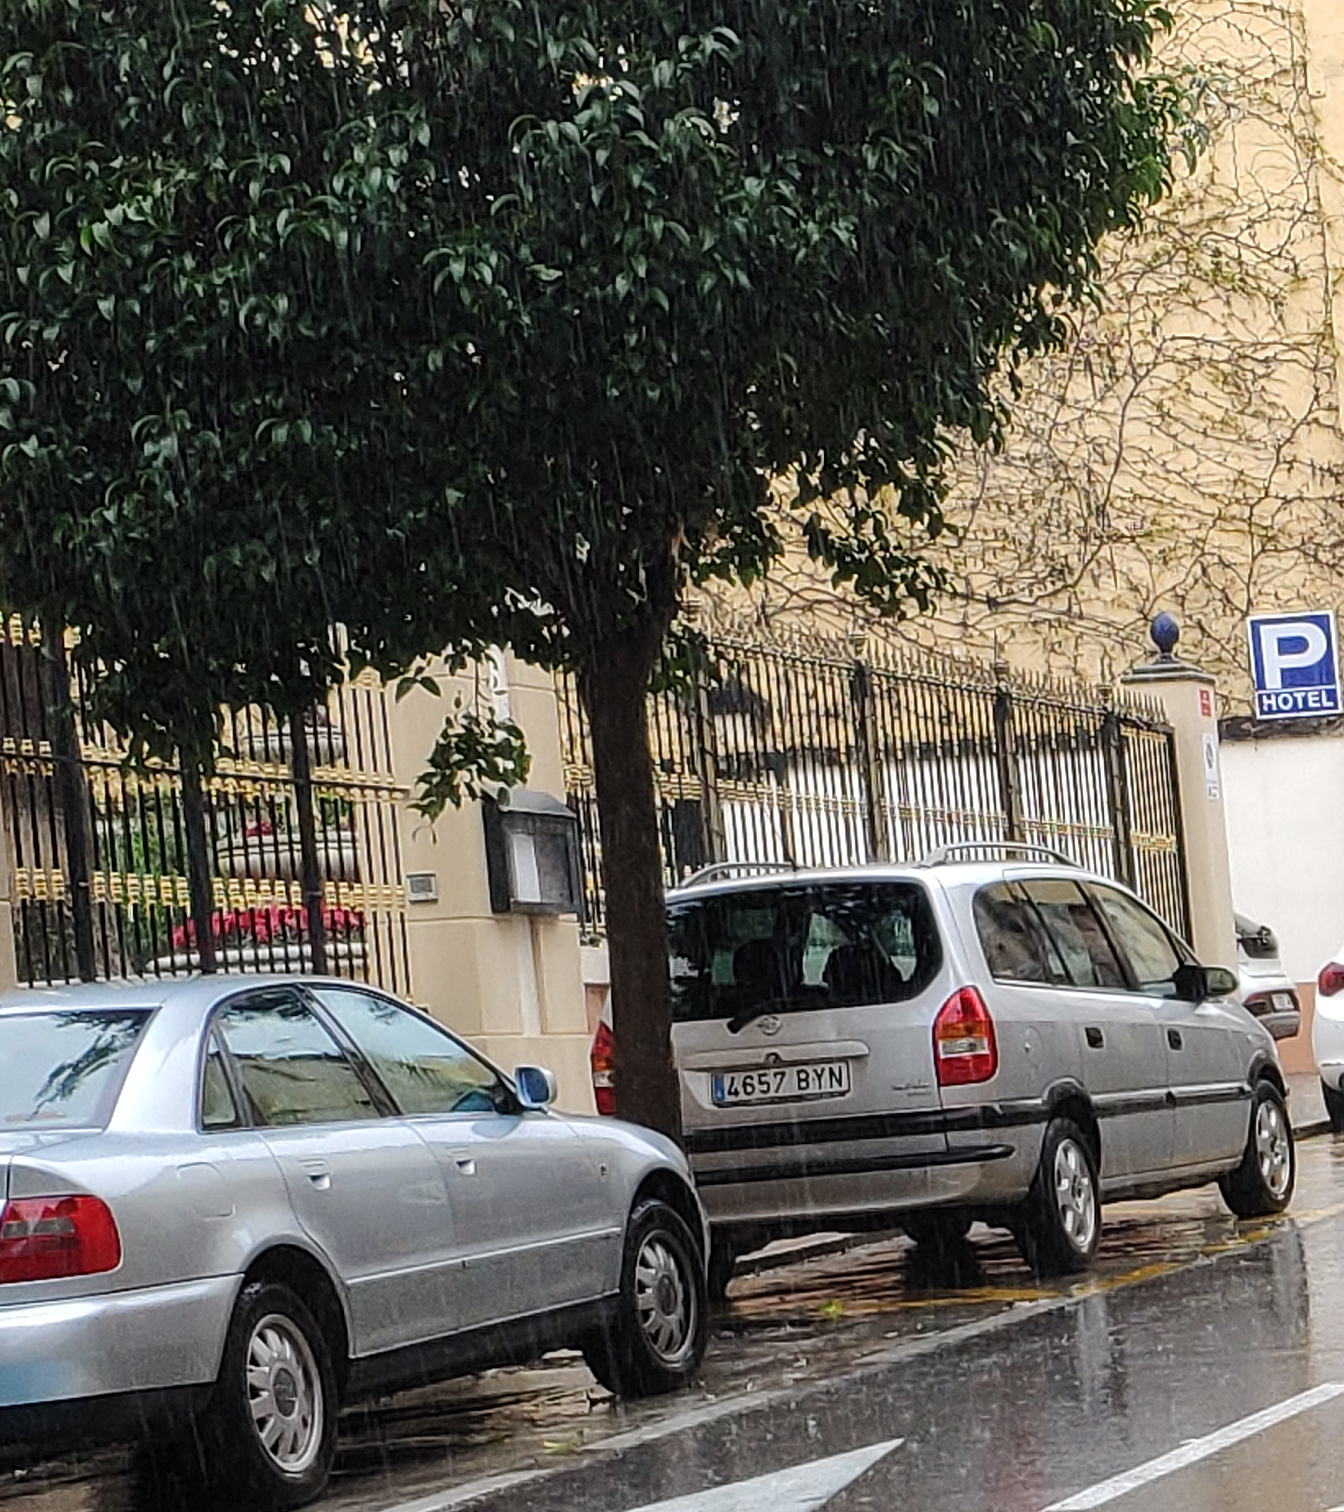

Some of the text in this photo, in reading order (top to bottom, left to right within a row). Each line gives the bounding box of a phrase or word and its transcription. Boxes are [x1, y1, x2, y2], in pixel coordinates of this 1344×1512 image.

[1260, 622, 1327, 689] P
[1262, 690, 1335, 711] HOTEL
[728, 1066, 843, 1098] 4657 BYN
